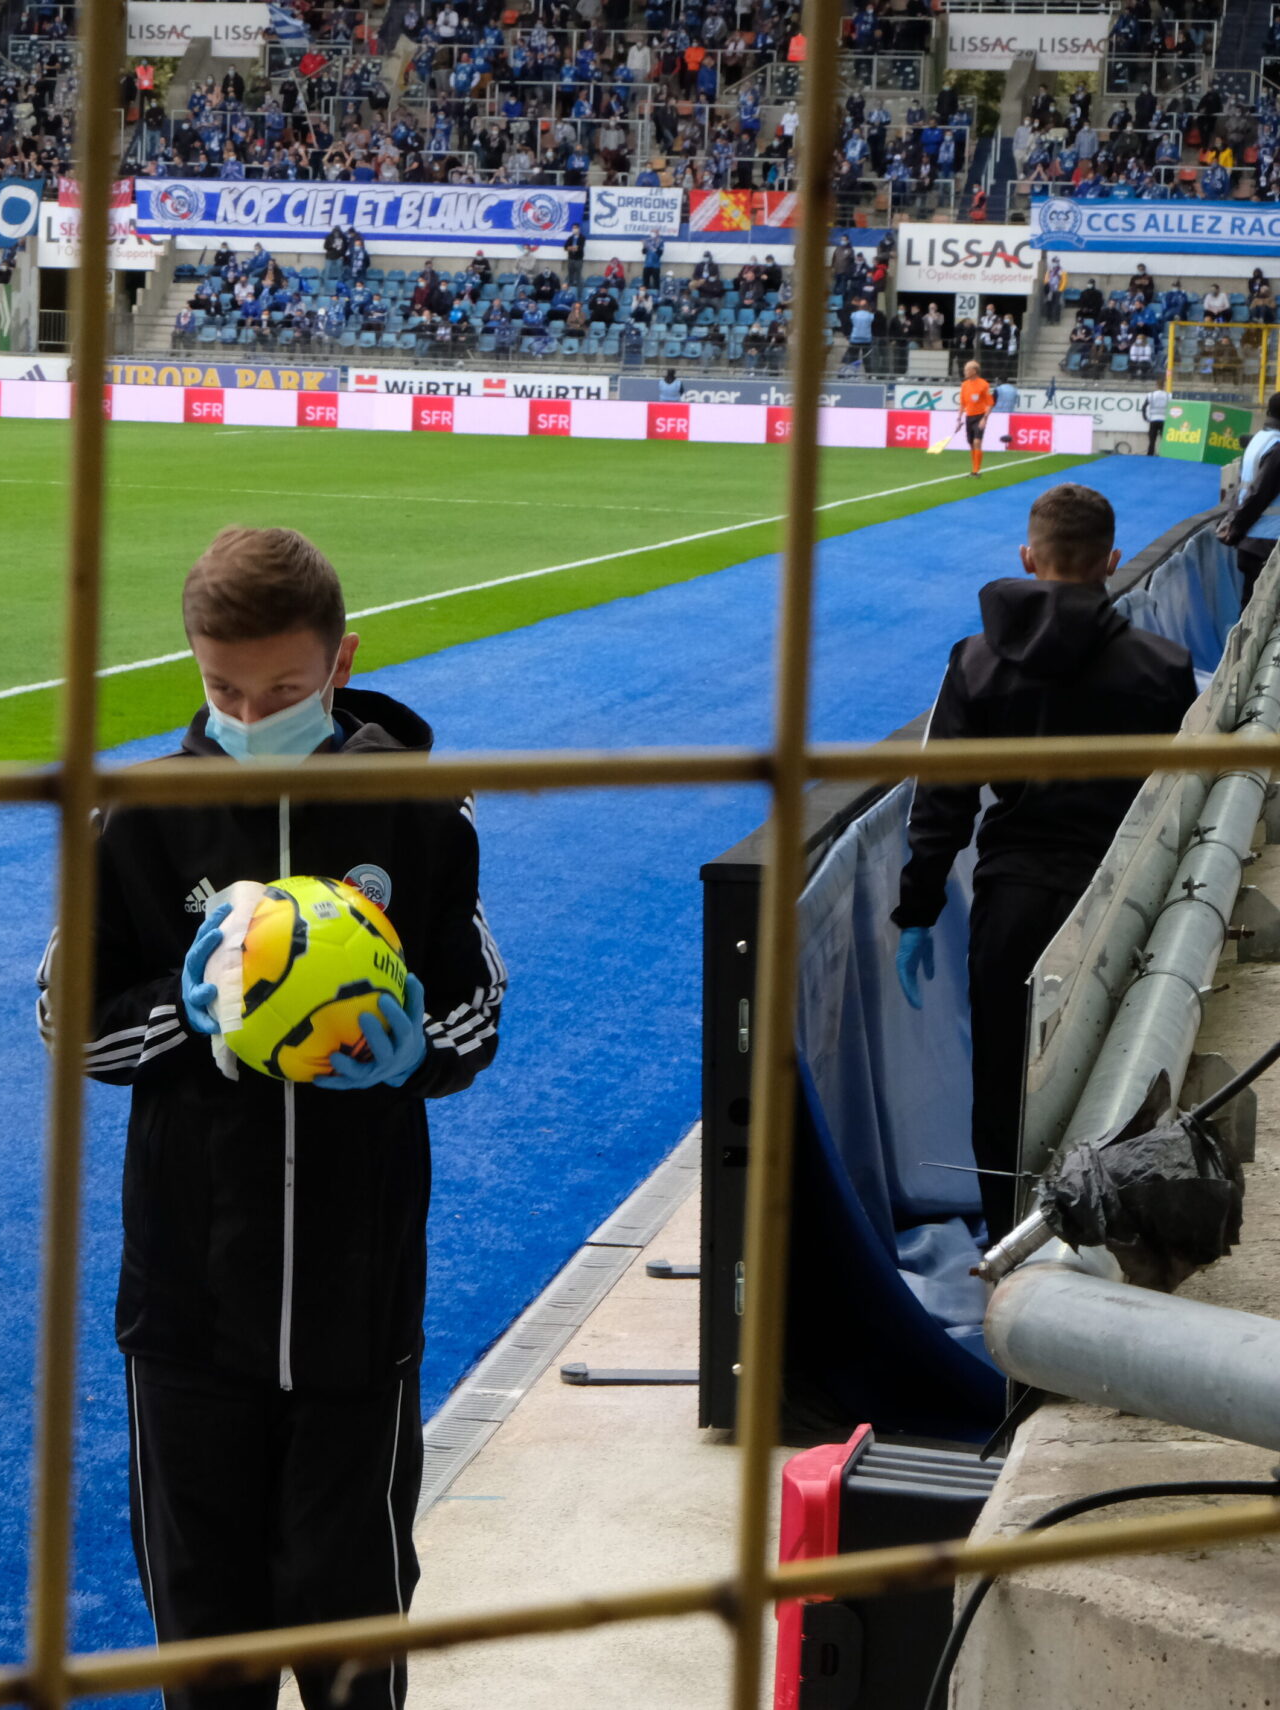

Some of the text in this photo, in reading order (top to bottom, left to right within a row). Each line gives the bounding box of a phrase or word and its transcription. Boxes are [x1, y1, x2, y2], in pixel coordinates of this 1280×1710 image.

[128, 24, 192, 40] LISSAC
[949, 36, 1017, 53] LISSAC
[215, 186, 283, 226] KOP
[283, 188, 349, 227] CIEL
[353, 190, 395, 228] ET
[396, 190, 501, 232] BLANC
[617, 196, 678, 210] DRAGONS
[630, 209, 674, 223] BLEUS
[1086, 213, 1136, 233] CCS
[1143, 213, 1223, 235] ALLEZ
[906, 238, 1033, 269] LISSAC
[958, 296, 976, 310] 20
[192, 402, 223, 417] SFR
[305, 406, 337, 421] SFR
[420, 409, 452, 426] SFR
[537, 413, 569, 429] SFR
[655, 417, 688, 433] SFR
[895, 425, 928, 441] SFR
[1017, 429, 1050, 445] SFR
